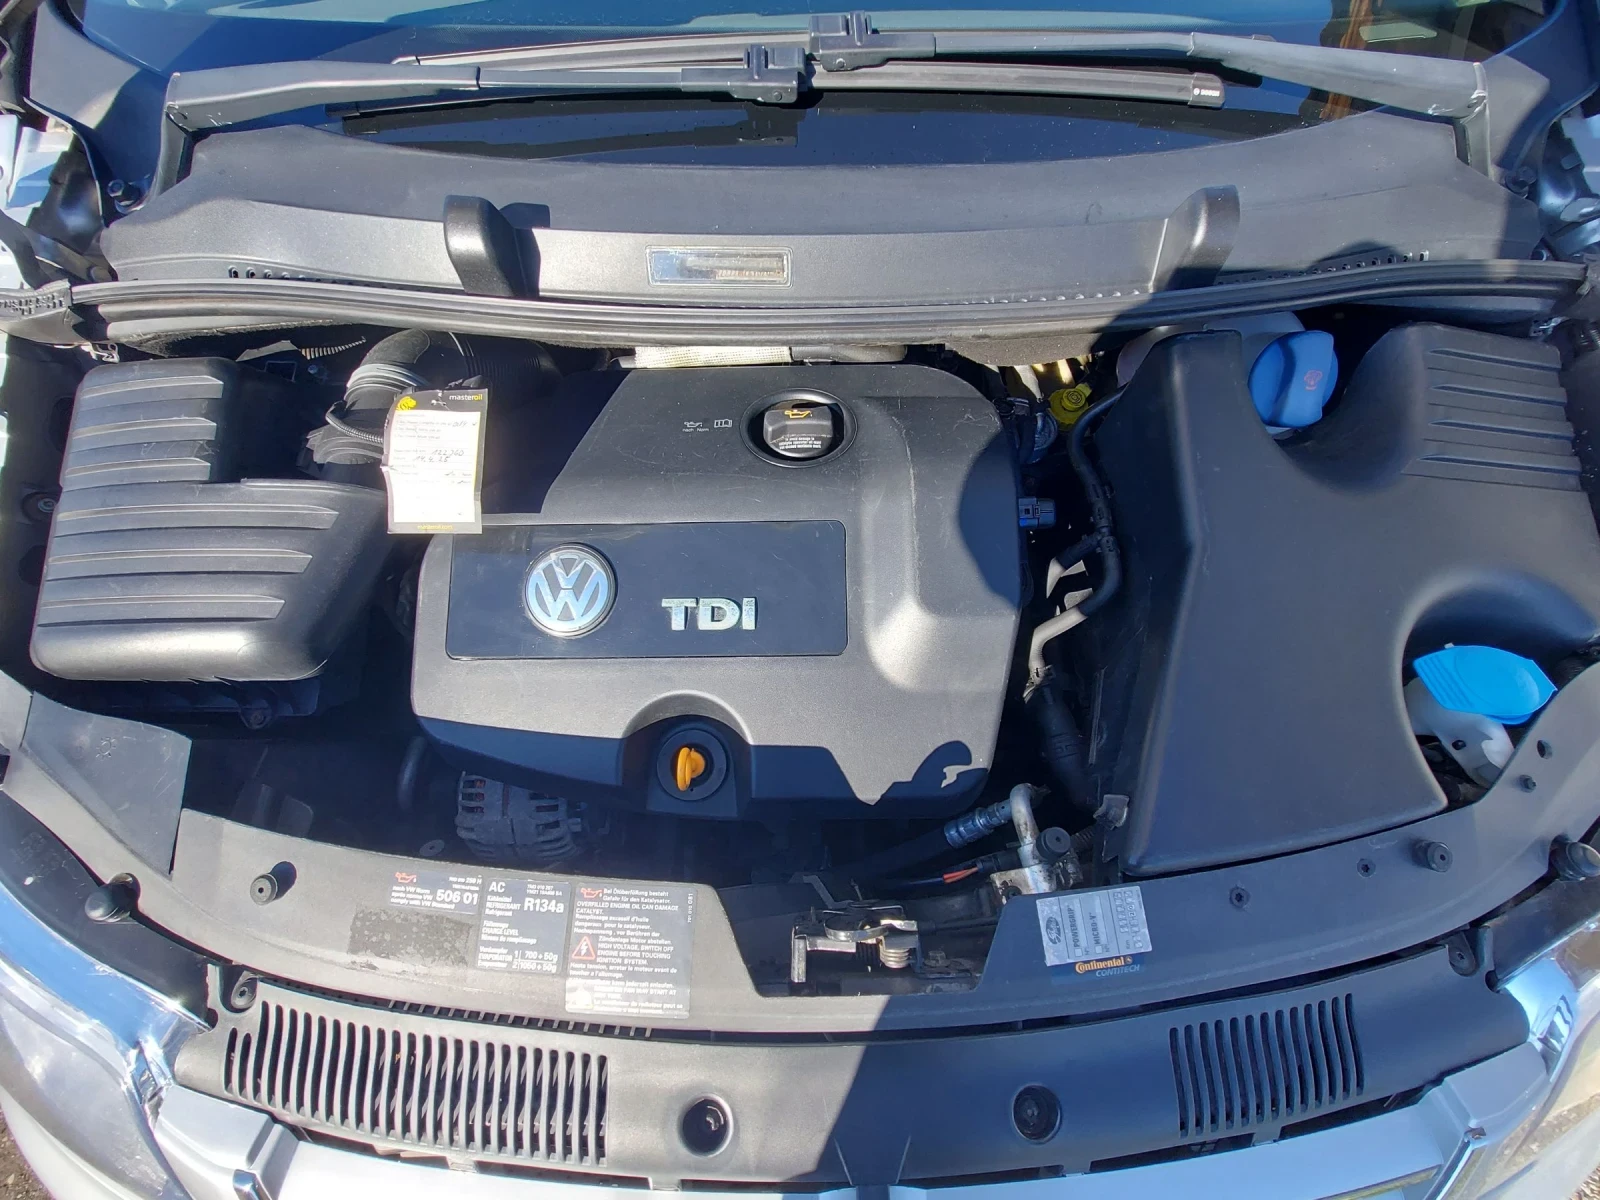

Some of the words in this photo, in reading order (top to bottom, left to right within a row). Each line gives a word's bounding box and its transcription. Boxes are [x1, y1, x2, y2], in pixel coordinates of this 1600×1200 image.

[662, 598, 756, 630] TDI
[489, 881, 506, 893] AC
[436, 889, 460, 903] 506
[463, 892, 479, 906] 01
[524, 898, 564, 913] R134a
[482, 927, 503, 935] CHARGE
[1067, 906, 1079, 947] POWERGRIP
[478, 952, 513, 962] EVAPORATOR
[524, 951, 537, 960] 700
[1075, 956, 1124, 973] Continental
[1096, 964, 1140, 977] CONTITECH
